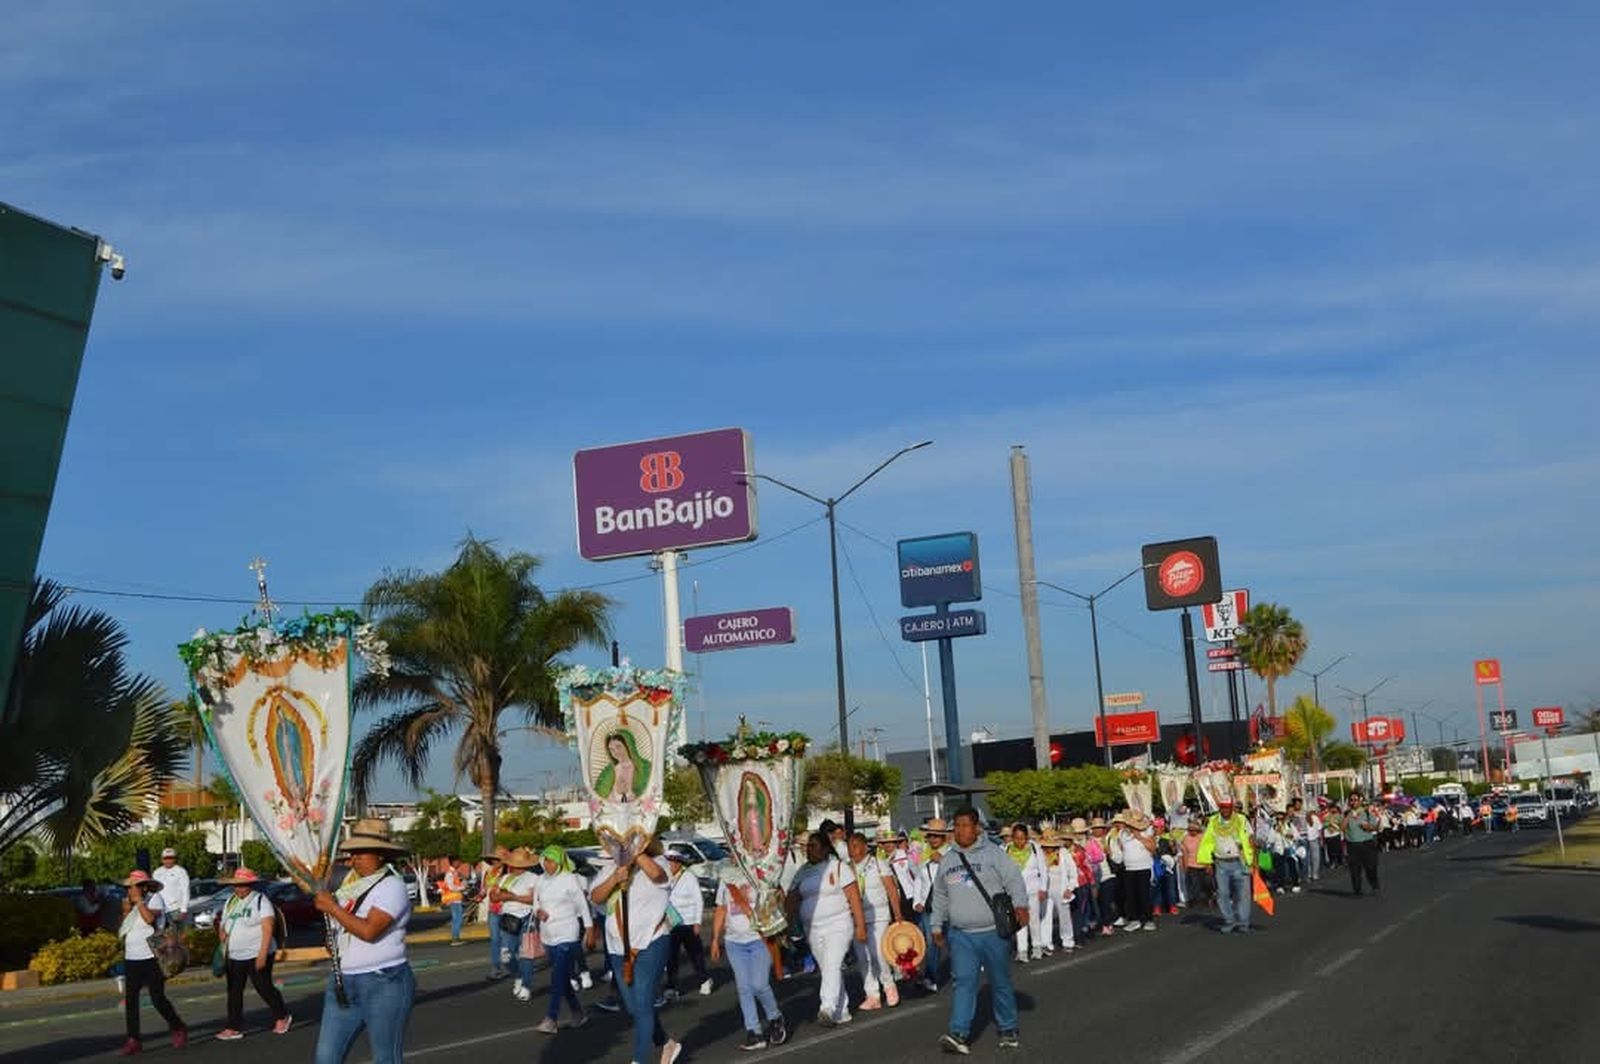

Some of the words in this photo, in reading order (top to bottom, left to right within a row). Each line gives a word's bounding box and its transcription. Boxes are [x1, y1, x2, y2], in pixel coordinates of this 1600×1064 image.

[595, 490, 734, 535] BanBajío
[902, 563, 963, 578] citibanamex
[717, 615, 759, 631] CAJERO
[904, 619, 945, 634] CAJERO
[952, 616, 974, 627] ATM
[702, 628, 777, 646] AUTOMATICO
[1213, 626, 1243, 640] KFC
